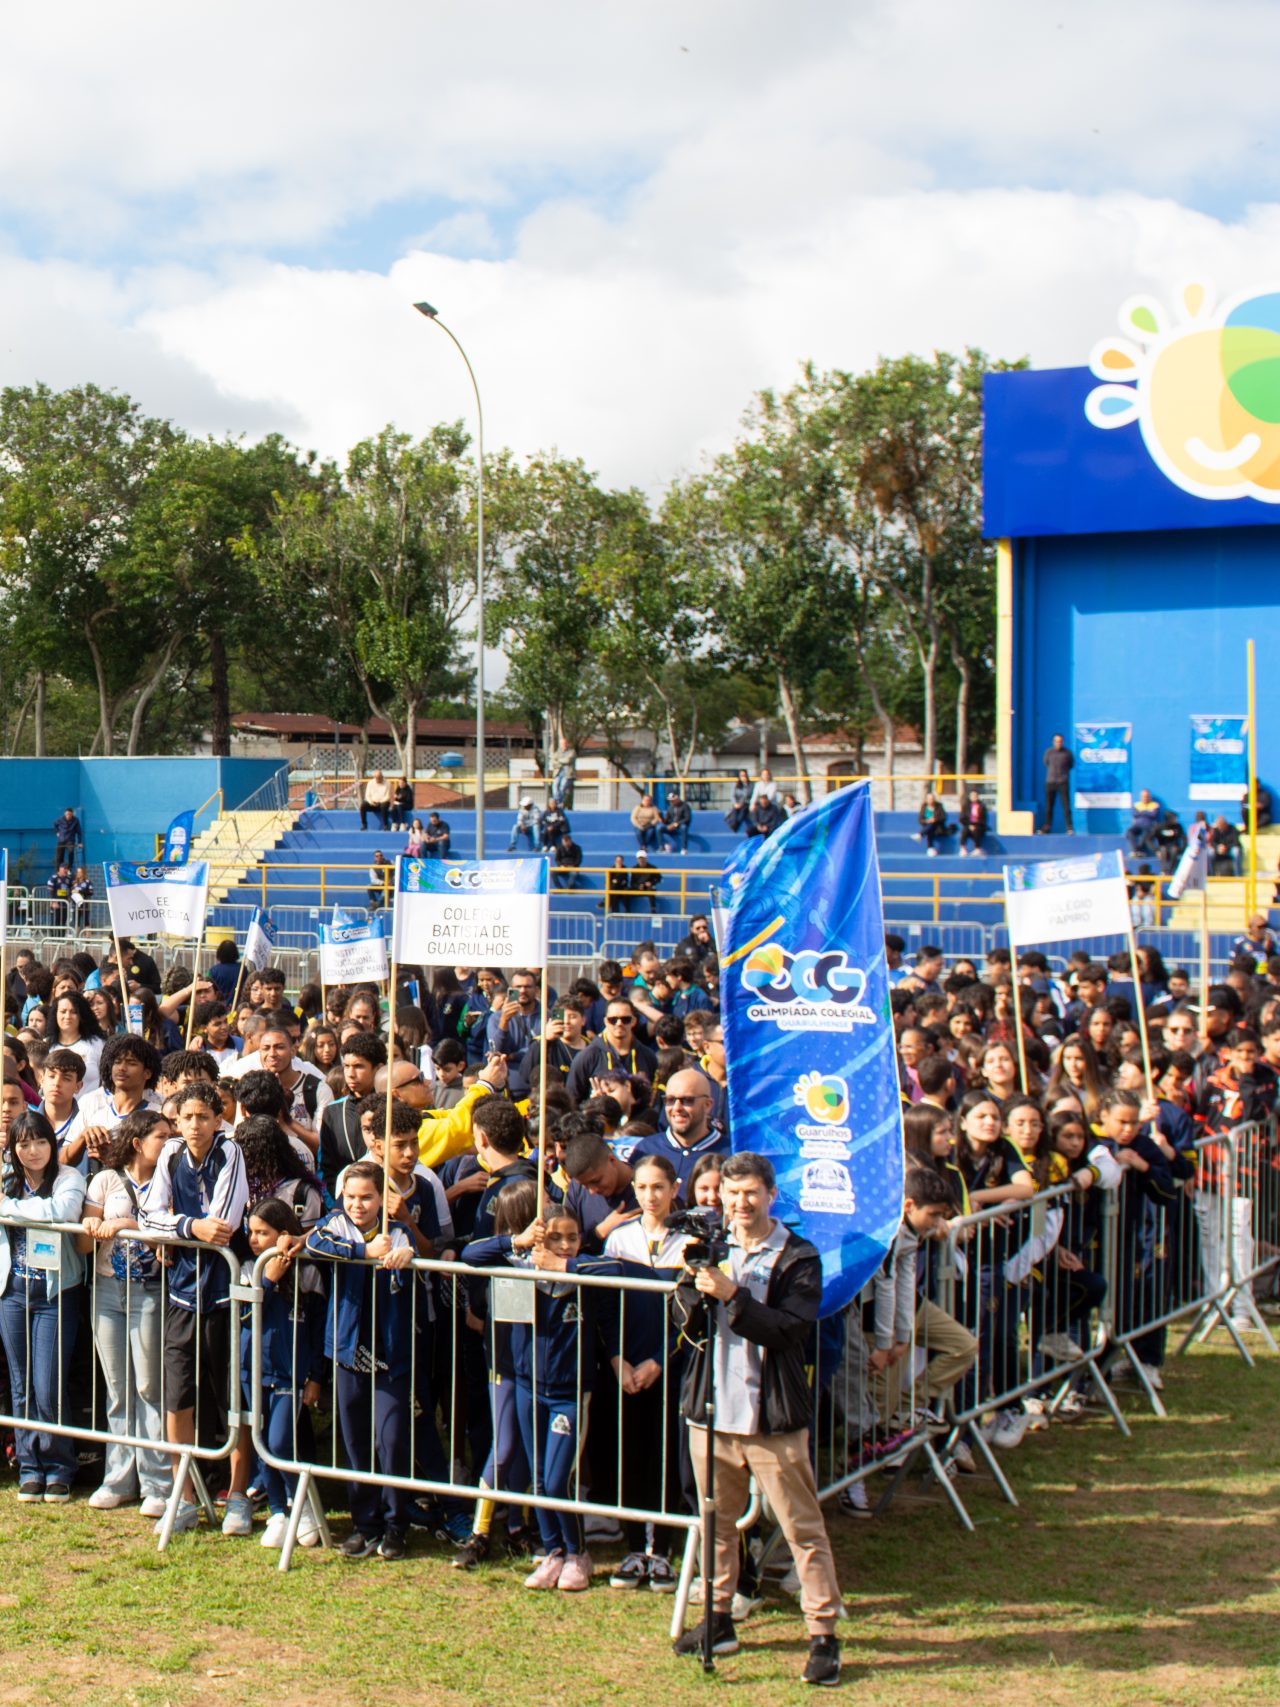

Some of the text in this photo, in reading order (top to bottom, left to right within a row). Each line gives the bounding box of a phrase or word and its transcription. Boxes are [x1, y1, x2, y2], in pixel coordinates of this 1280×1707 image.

[156, 896, 169, 907] EE
[128, 908, 167, 921] VICTOR
[443, 906, 502, 921] COLGO
[432, 924, 510, 939] BATISTA DE
[427, 941, 513, 956] GUARULHOS
[751, 1005, 874, 1020] OLIMPÍADA COLEGIAL
[799, 1126, 849, 1138] Guarulhos
